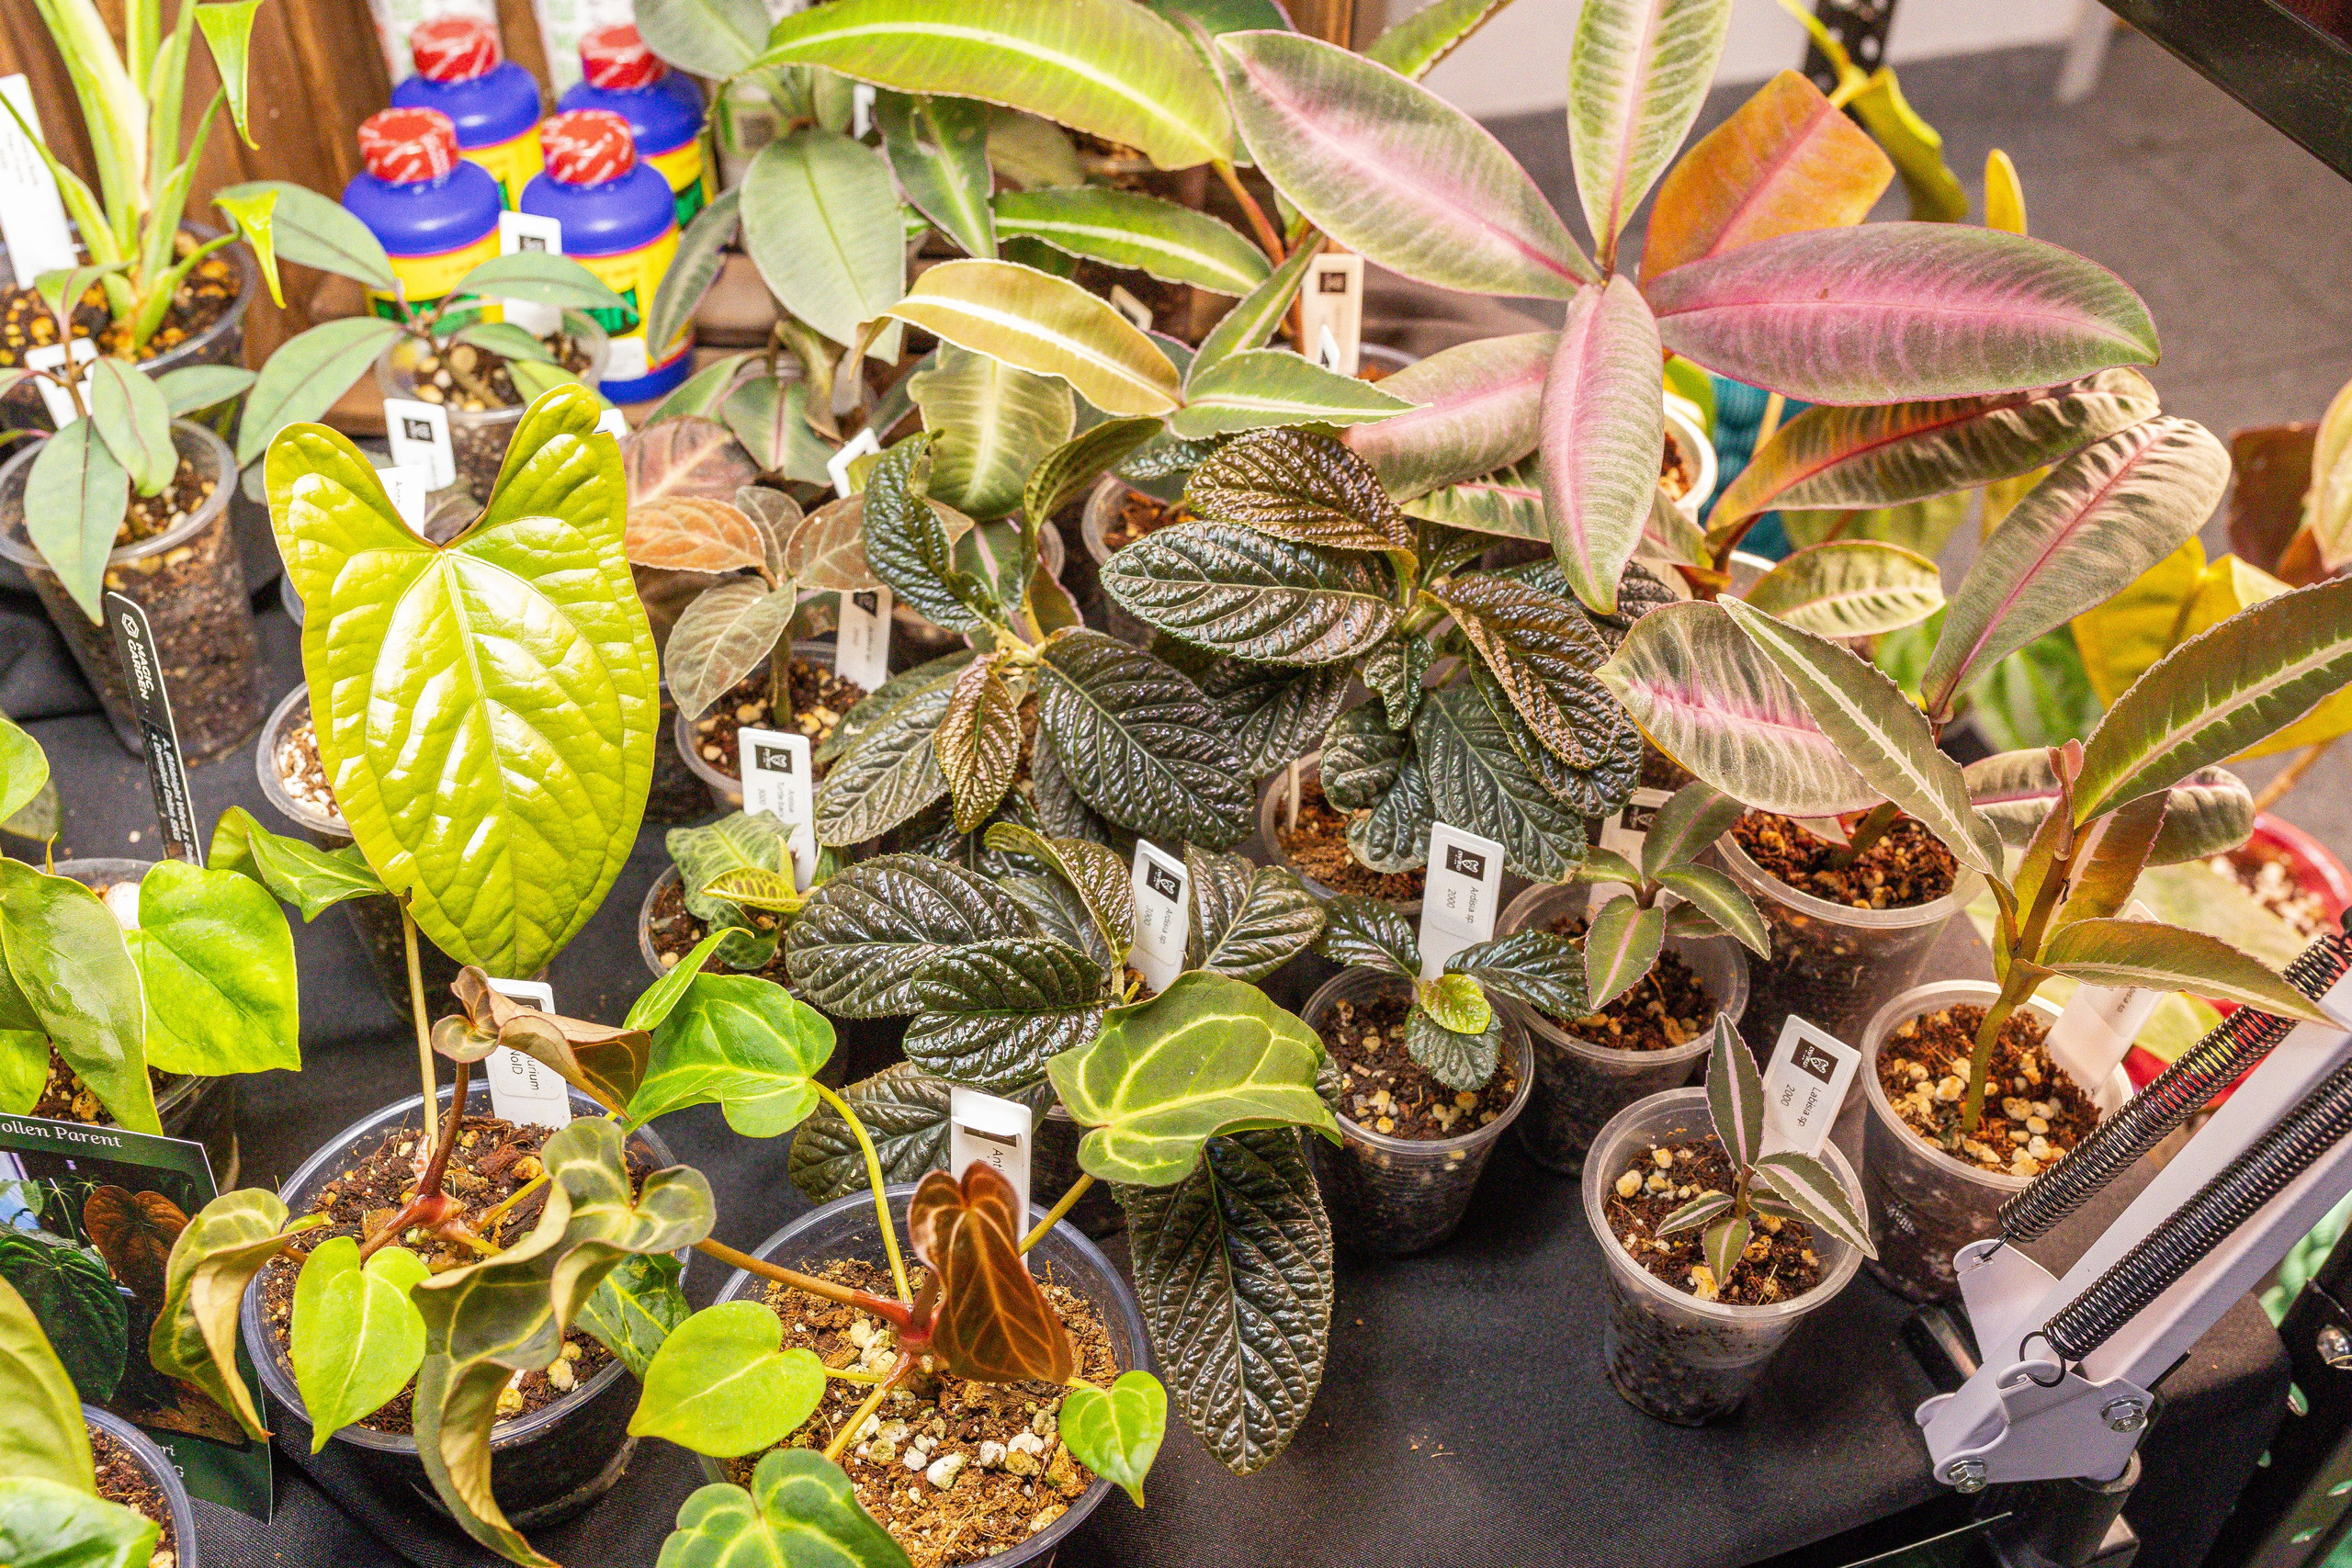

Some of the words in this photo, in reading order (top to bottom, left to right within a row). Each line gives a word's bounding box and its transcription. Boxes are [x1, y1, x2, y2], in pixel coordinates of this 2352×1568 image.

[128, 638, 149, 700] GARDEN
[136, 642, 154, 692] MAGIC
[1446, 888, 1457, 909] 2000
[1467, 886, 1479, 913] Ardisia
[1143, 905, 1154, 927] 3000
[1161, 907, 1173, 934] Ardisia
[1781, 1084, 1795, 1107] 2000
[1803, 1087, 1822, 1116] Labisia
[0, 1120, 51, 1138] ollen
[53, 1126, 123, 1148] Parent
